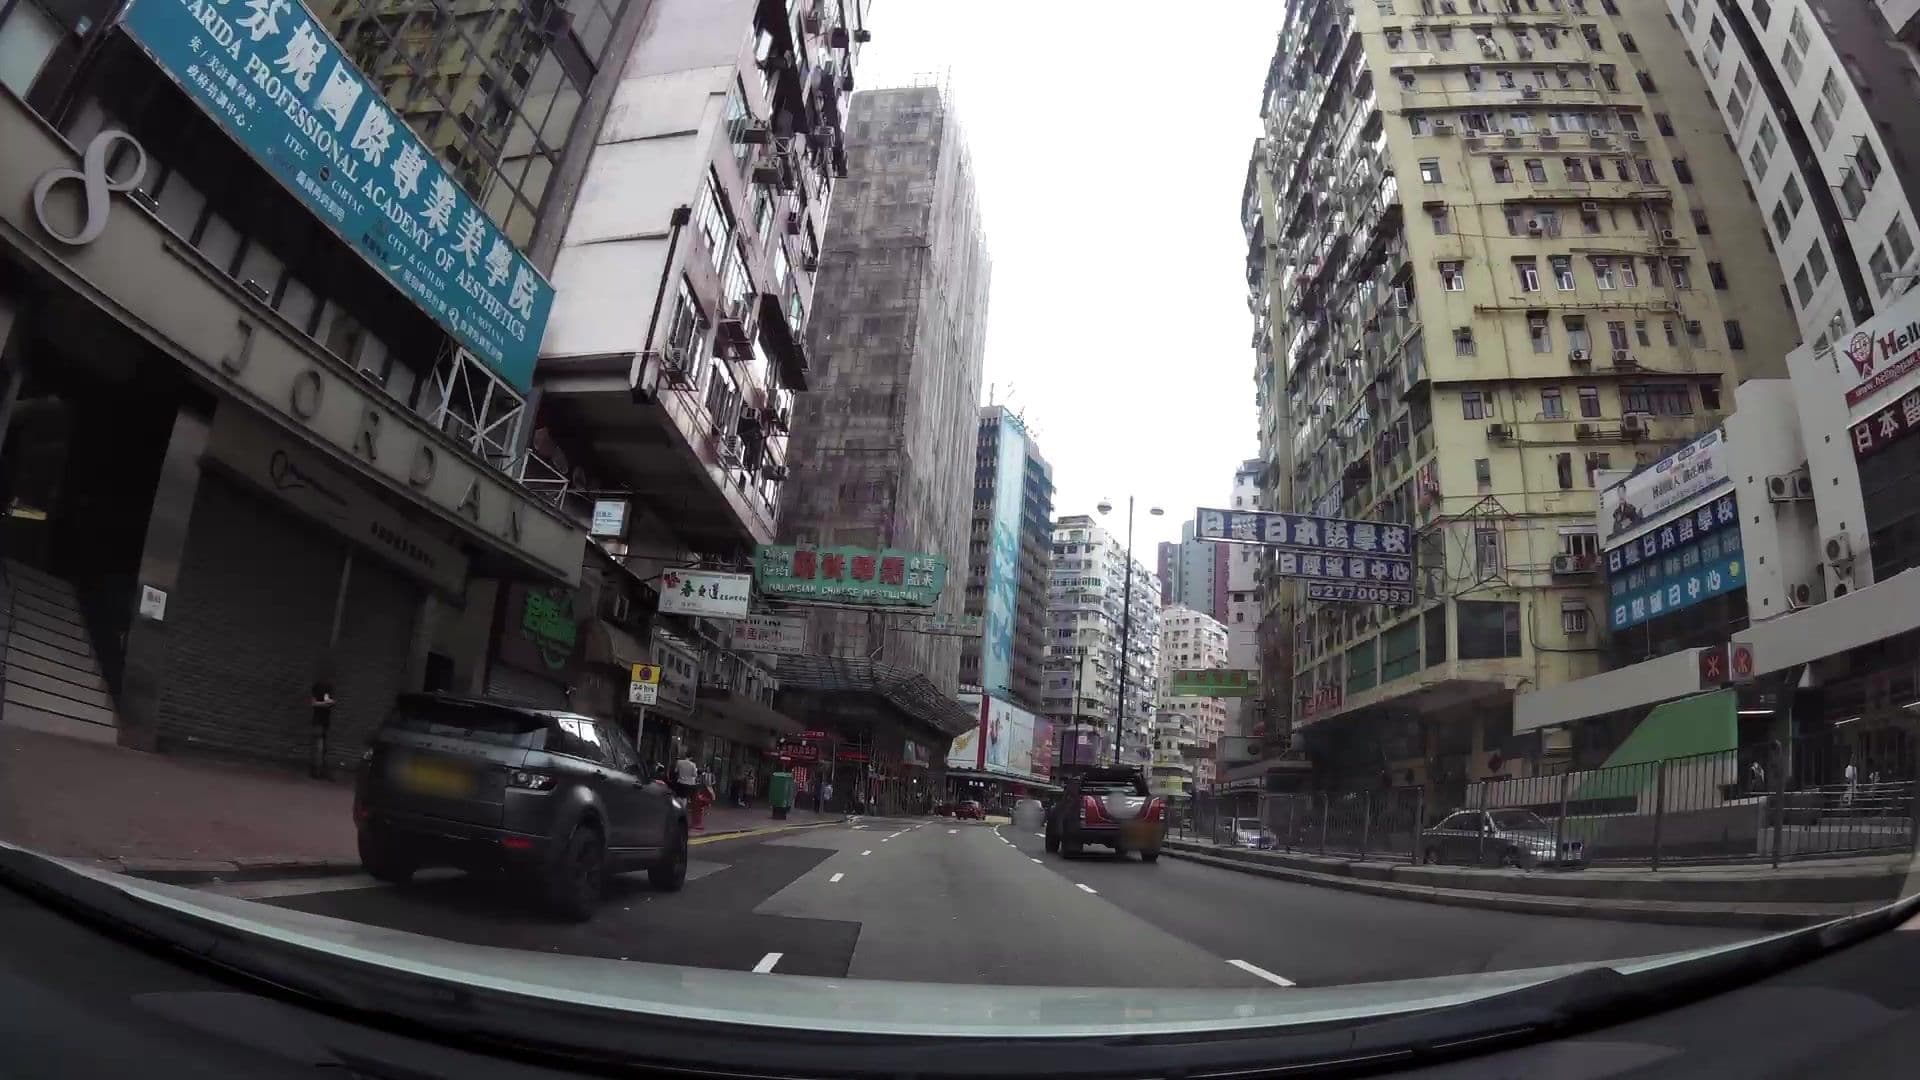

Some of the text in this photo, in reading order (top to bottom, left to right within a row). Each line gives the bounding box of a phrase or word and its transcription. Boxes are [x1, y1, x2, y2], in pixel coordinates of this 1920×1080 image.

[181, 0, 242, 60] ARIDA
[243, 53, 359, 184] PROFESSIONAL
[361, 178, 435, 253] ACADEMY
[435, 247, 455, 273] OF
[455, 268, 527, 343] AESTHETICS
[217, 0, 538, 320] 芬妮國際專業美學院
[284, 133, 309, 161] ITEC
[388, 233, 408, 257] CITY
[408, 254, 416, 265] &
[416, 261, 447, 291] GUILDS
[1876, 321, 1920, 361] Hell
[1323, 585, 1410, 602] 27700993
